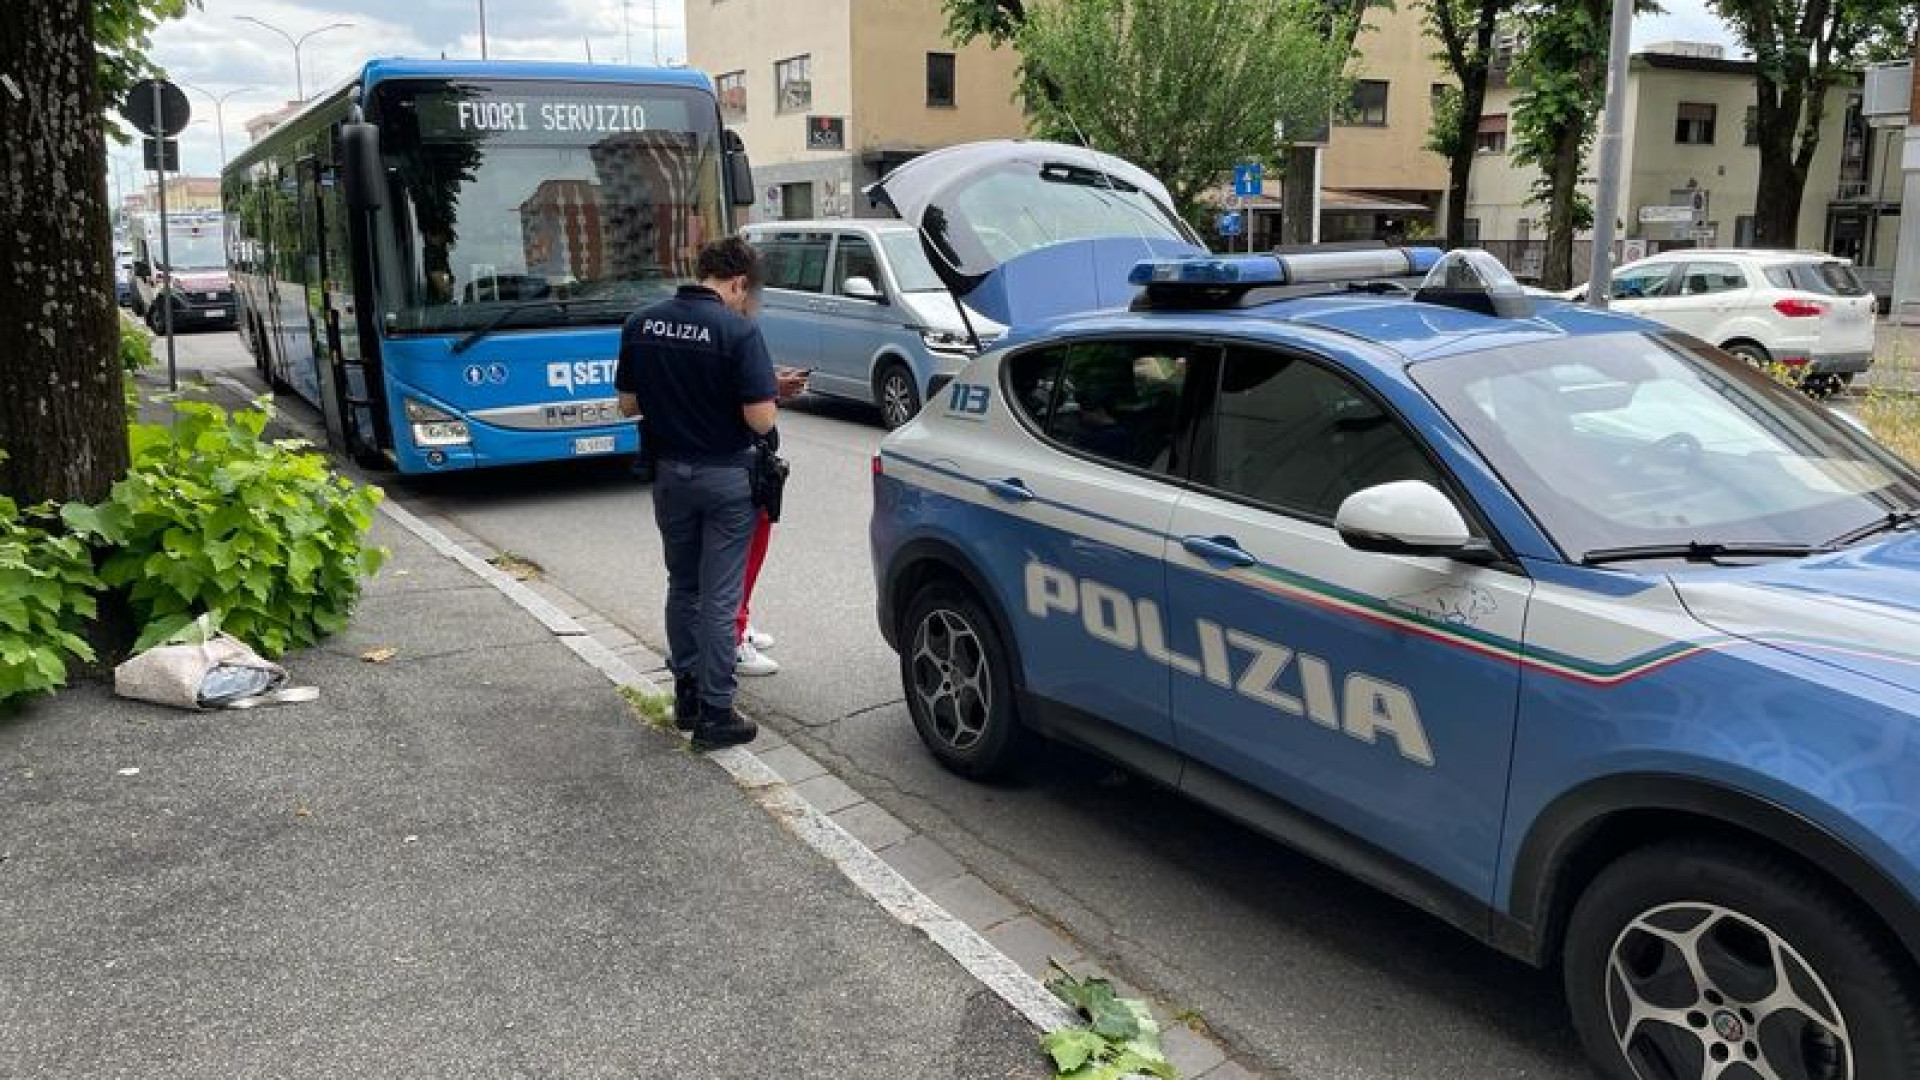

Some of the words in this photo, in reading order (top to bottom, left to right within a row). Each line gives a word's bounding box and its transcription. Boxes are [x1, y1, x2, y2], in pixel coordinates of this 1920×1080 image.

[458, 102, 528, 131] FUORI
[541, 103, 646, 132] SERVIZIO
[643, 319, 711, 343] POLIZIA
[950, 383, 991, 415] 113
[1023, 560, 1436, 768] POLIZIA
